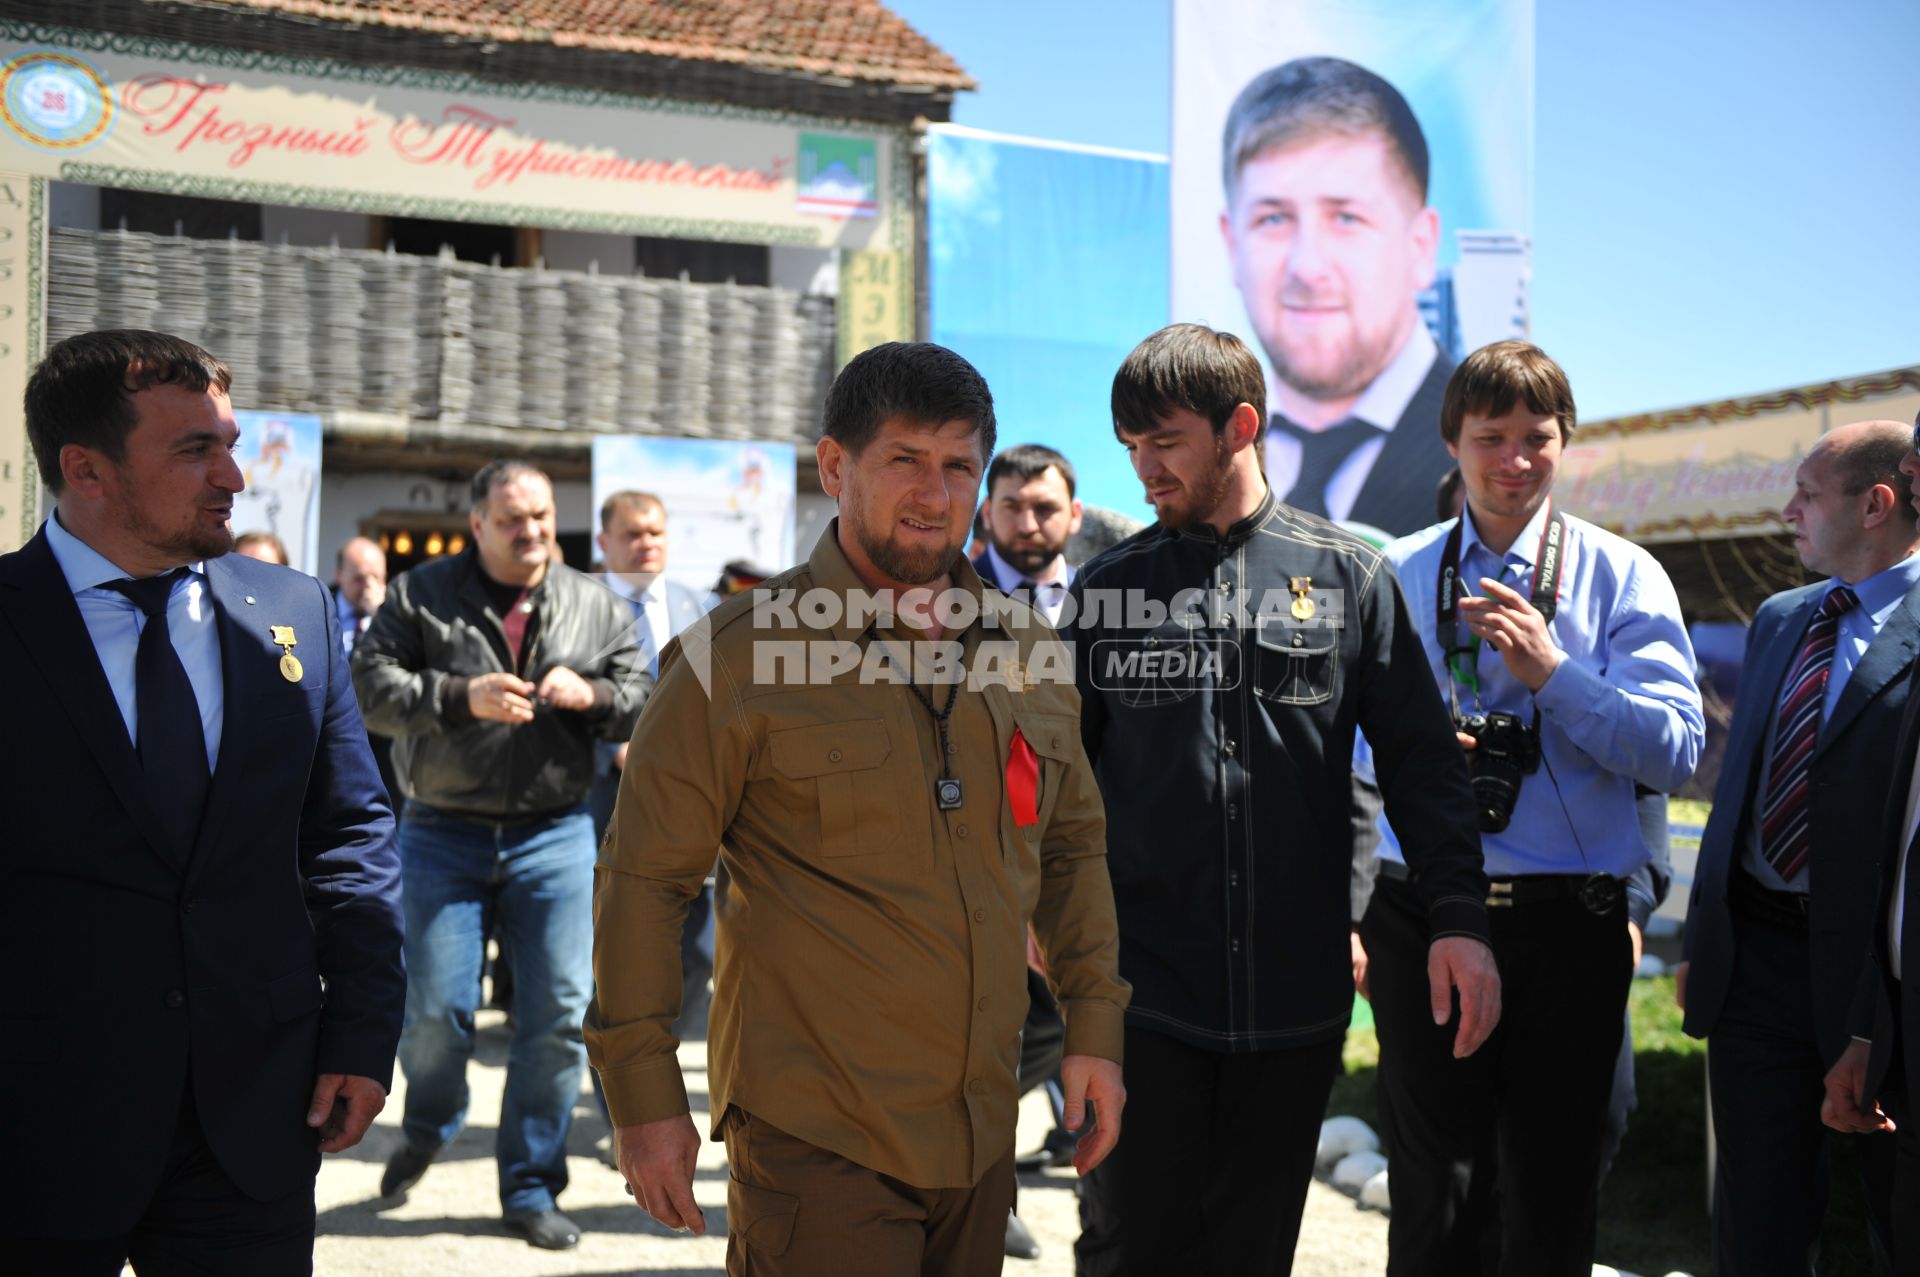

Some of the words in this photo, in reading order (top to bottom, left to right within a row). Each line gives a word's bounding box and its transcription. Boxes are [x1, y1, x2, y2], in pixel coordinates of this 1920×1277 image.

[122, 72, 381, 169] Грозный
[388, 103, 791, 192] Туристический
[1548, 521, 1561, 546] EOS
[1443, 566, 1454, 610] Canon
[1541, 545, 1556, 591] DIGITAL
